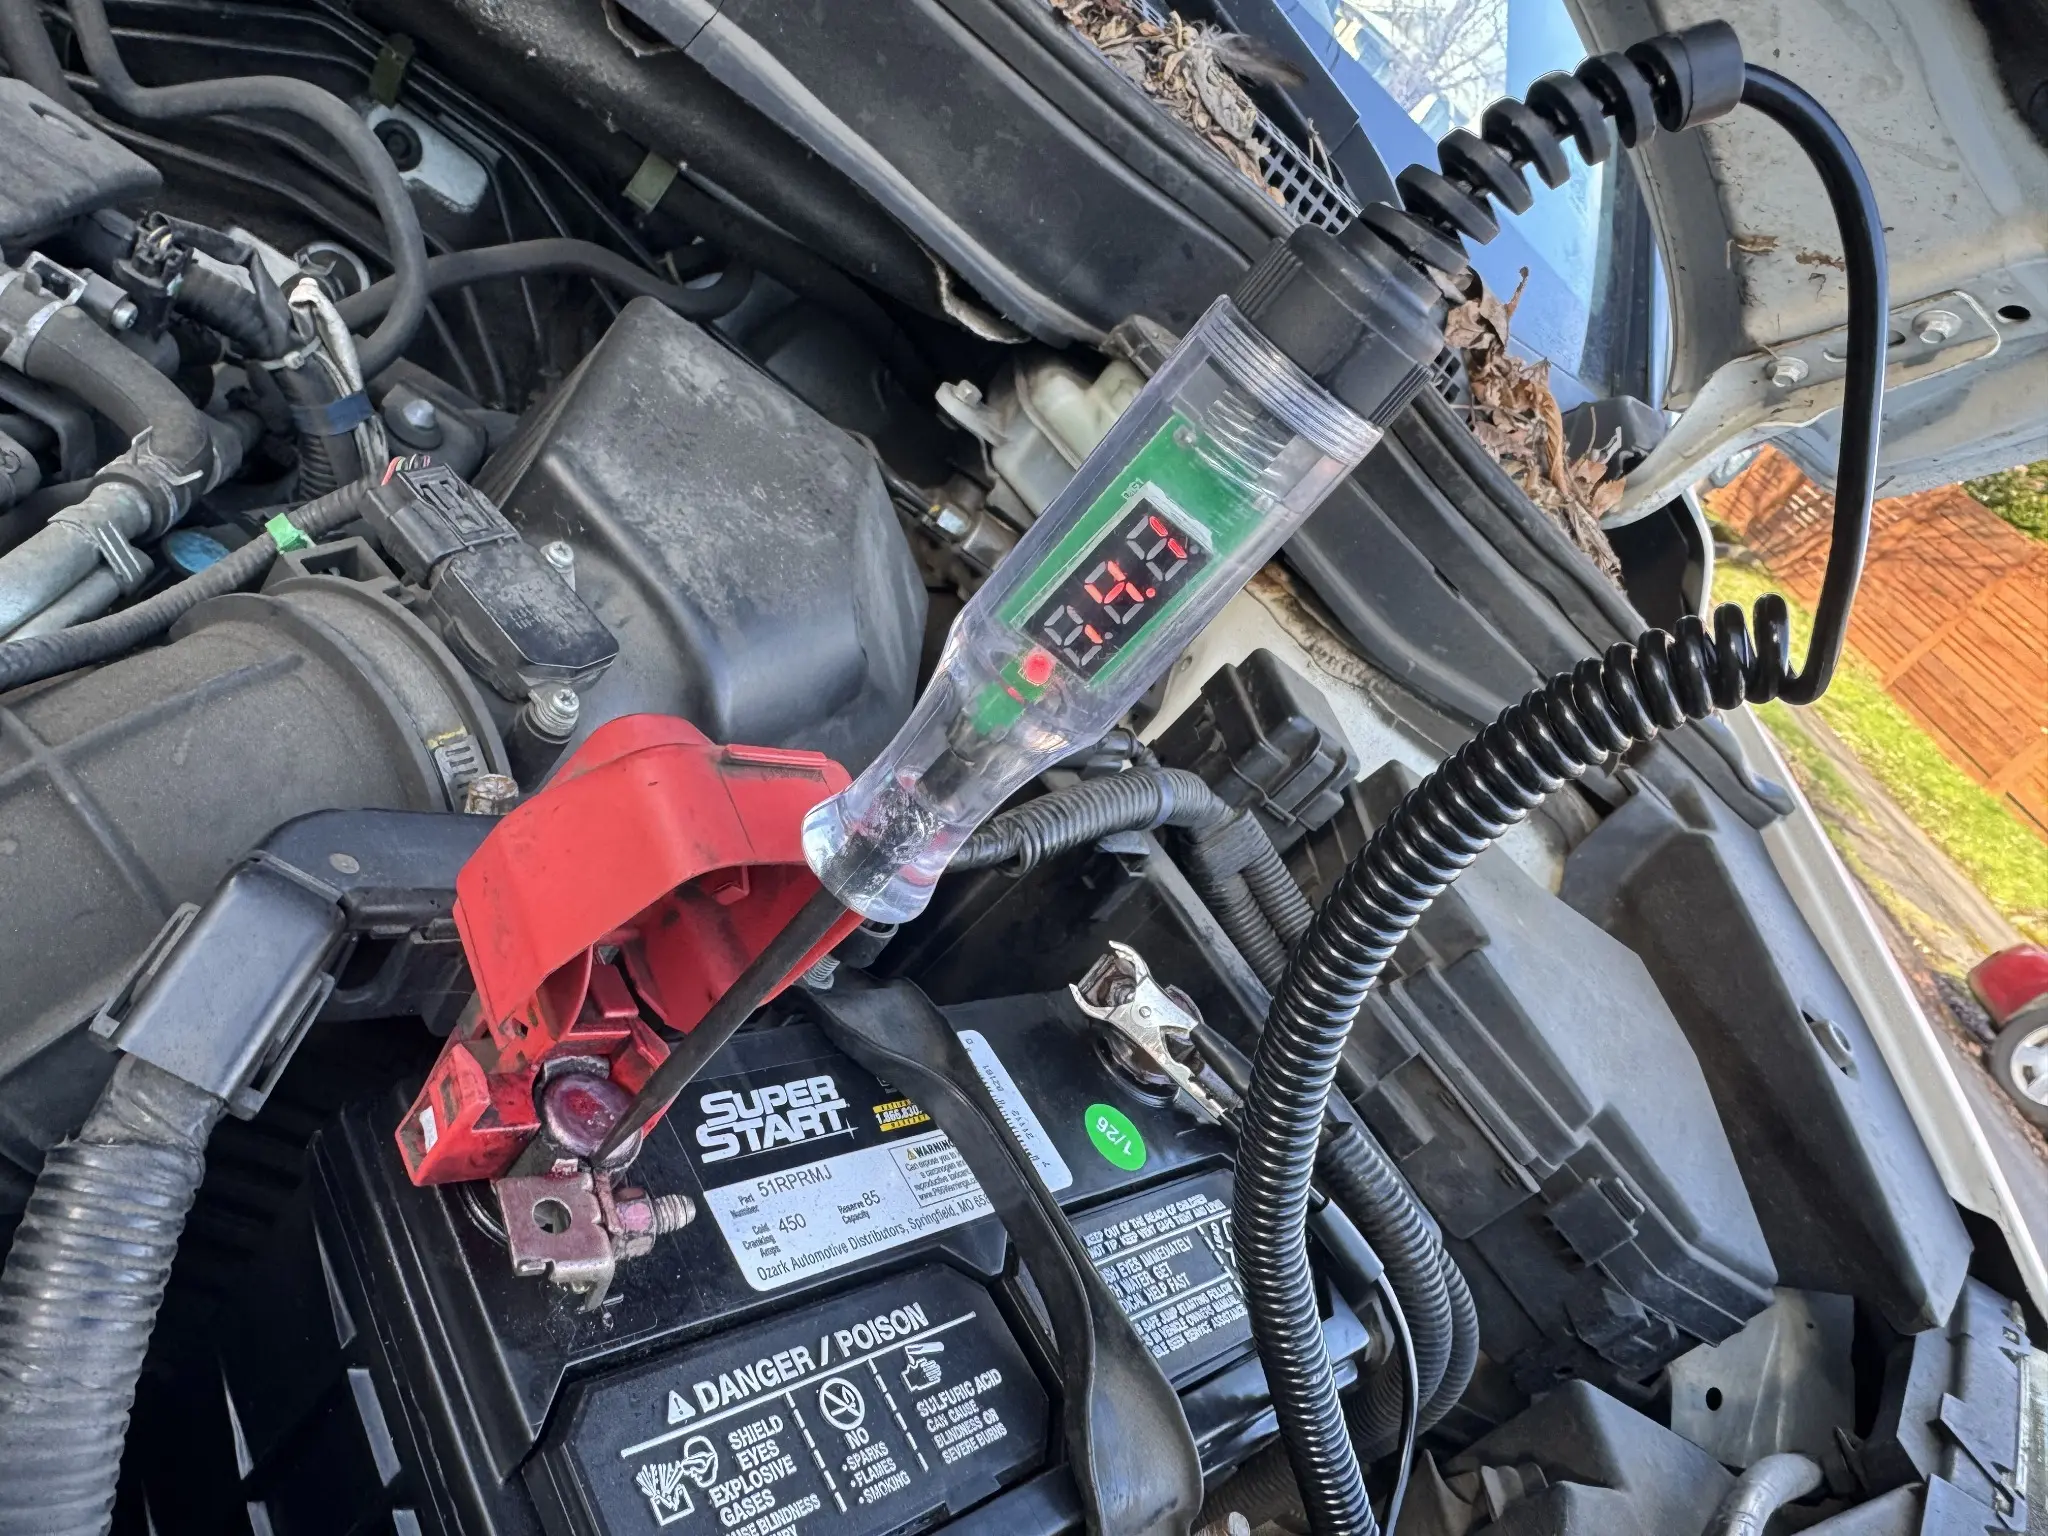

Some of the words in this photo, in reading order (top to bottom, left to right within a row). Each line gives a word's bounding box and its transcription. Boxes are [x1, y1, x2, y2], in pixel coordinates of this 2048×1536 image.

[700, 1085, 838, 1128] SUPER
[696, 1099, 847, 1164] START
[1095, 1116, 1131, 1155] 1/26
[738, 1193, 755, 1205] Part
[757, 1164, 833, 1198] 51RPRMJ
[862, 1190, 881, 1207] 85
[757, 1259, 791, 1281] Ozark
[790, 1241, 849, 1270] Automotive
[848, 1223, 909, 1250] Distributors,
[908, 1205, 960, 1230] Springfield,
[957, 1196, 974, 1213] MO
[778, 1213, 807, 1234] 450
[1103, 1225, 1121, 1239] OUT
[1129, 1215, 1143, 1228] THE
[1100, 1266, 1120, 1283] USH
[1116, 1256, 1143, 1277] EYES
[1139, 1235, 1193, 1268] IMMEDIATELY
[1108, 1284, 1124, 1298] TH
[1153, 1261, 1173, 1280] GET
[1118, 1293, 1147, 1314] DICAL
[1143, 1282, 1167, 1303] HELP
[1167, 1272, 1190, 1293] FAST
[692, 1345, 816, 1413] DANGER
[833, 1302, 929, 1357] POISON
[916, 1380, 975, 1418] SULFURIC
[973, 1368, 1003, 1395] ACID
[727, 1415, 784, 1450] SHIELD
[926, 1413, 949, 1433] CAN
[948, 1399, 979, 1423] CAUSE
[933, 1415, 983, 1449] BLINDNESS
[983, 1407, 1000, 1425] OR
[736, 1438, 780, 1472] EYES
[845, 1427, 869, 1450] NO
[846, 1440, 889, 1471] SPARKS
[941, 1436, 979, 1465] SEVERE
[978, 1422, 1008, 1447] BURNS
[708, 1454, 797, 1508] EXPLOSIVE
[853, 1457, 897, 1487] FLAMES
[863, 1470, 911, 1504] SMOKING
[719, 1488, 776, 1527] GASES
[756, 1493, 821, 1536] BLINDNESS
